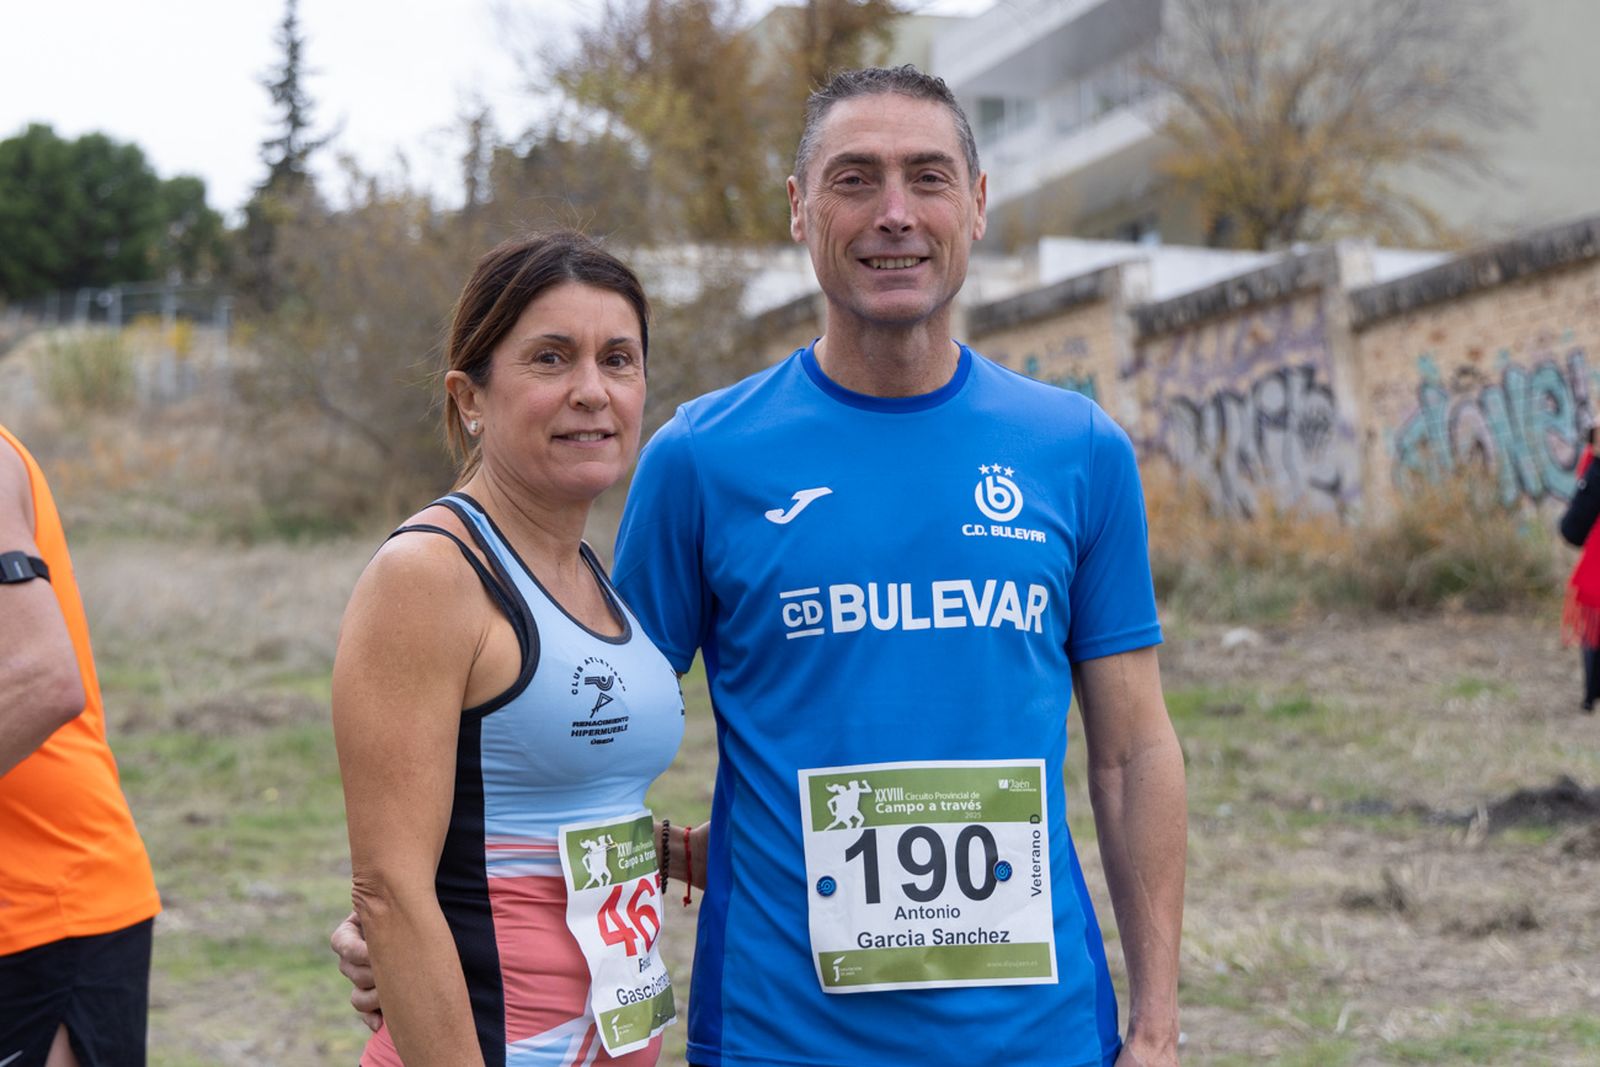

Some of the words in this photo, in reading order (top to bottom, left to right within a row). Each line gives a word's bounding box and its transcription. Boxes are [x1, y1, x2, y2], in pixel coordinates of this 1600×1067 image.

[962, 524, 988, 536] C.D.
[990, 525, 1046, 543] BULEVAR
[782, 600, 824, 628] CD
[829, 579, 1048, 633] BULEVAR
[571, 665, 584, 695] CLUB
[874, 787, 904, 802] XXVIII
[905, 792, 934, 801] Circuito
[934, 791, 969, 800] Provincial
[875, 803, 925, 815] Campo
[929, 803, 937, 811] a
[941, 800, 982, 811] través
[1029, 814, 1041, 824] D
[845, 824, 999, 904] 190
[1031, 830, 1042, 897] Veterano
[597, 870, 661, 957] 46
[894, 905, 961, 920] Antonio
[857, 928, 926, 948] Garcia
[932, 927, 1011, 945] Sanchez
